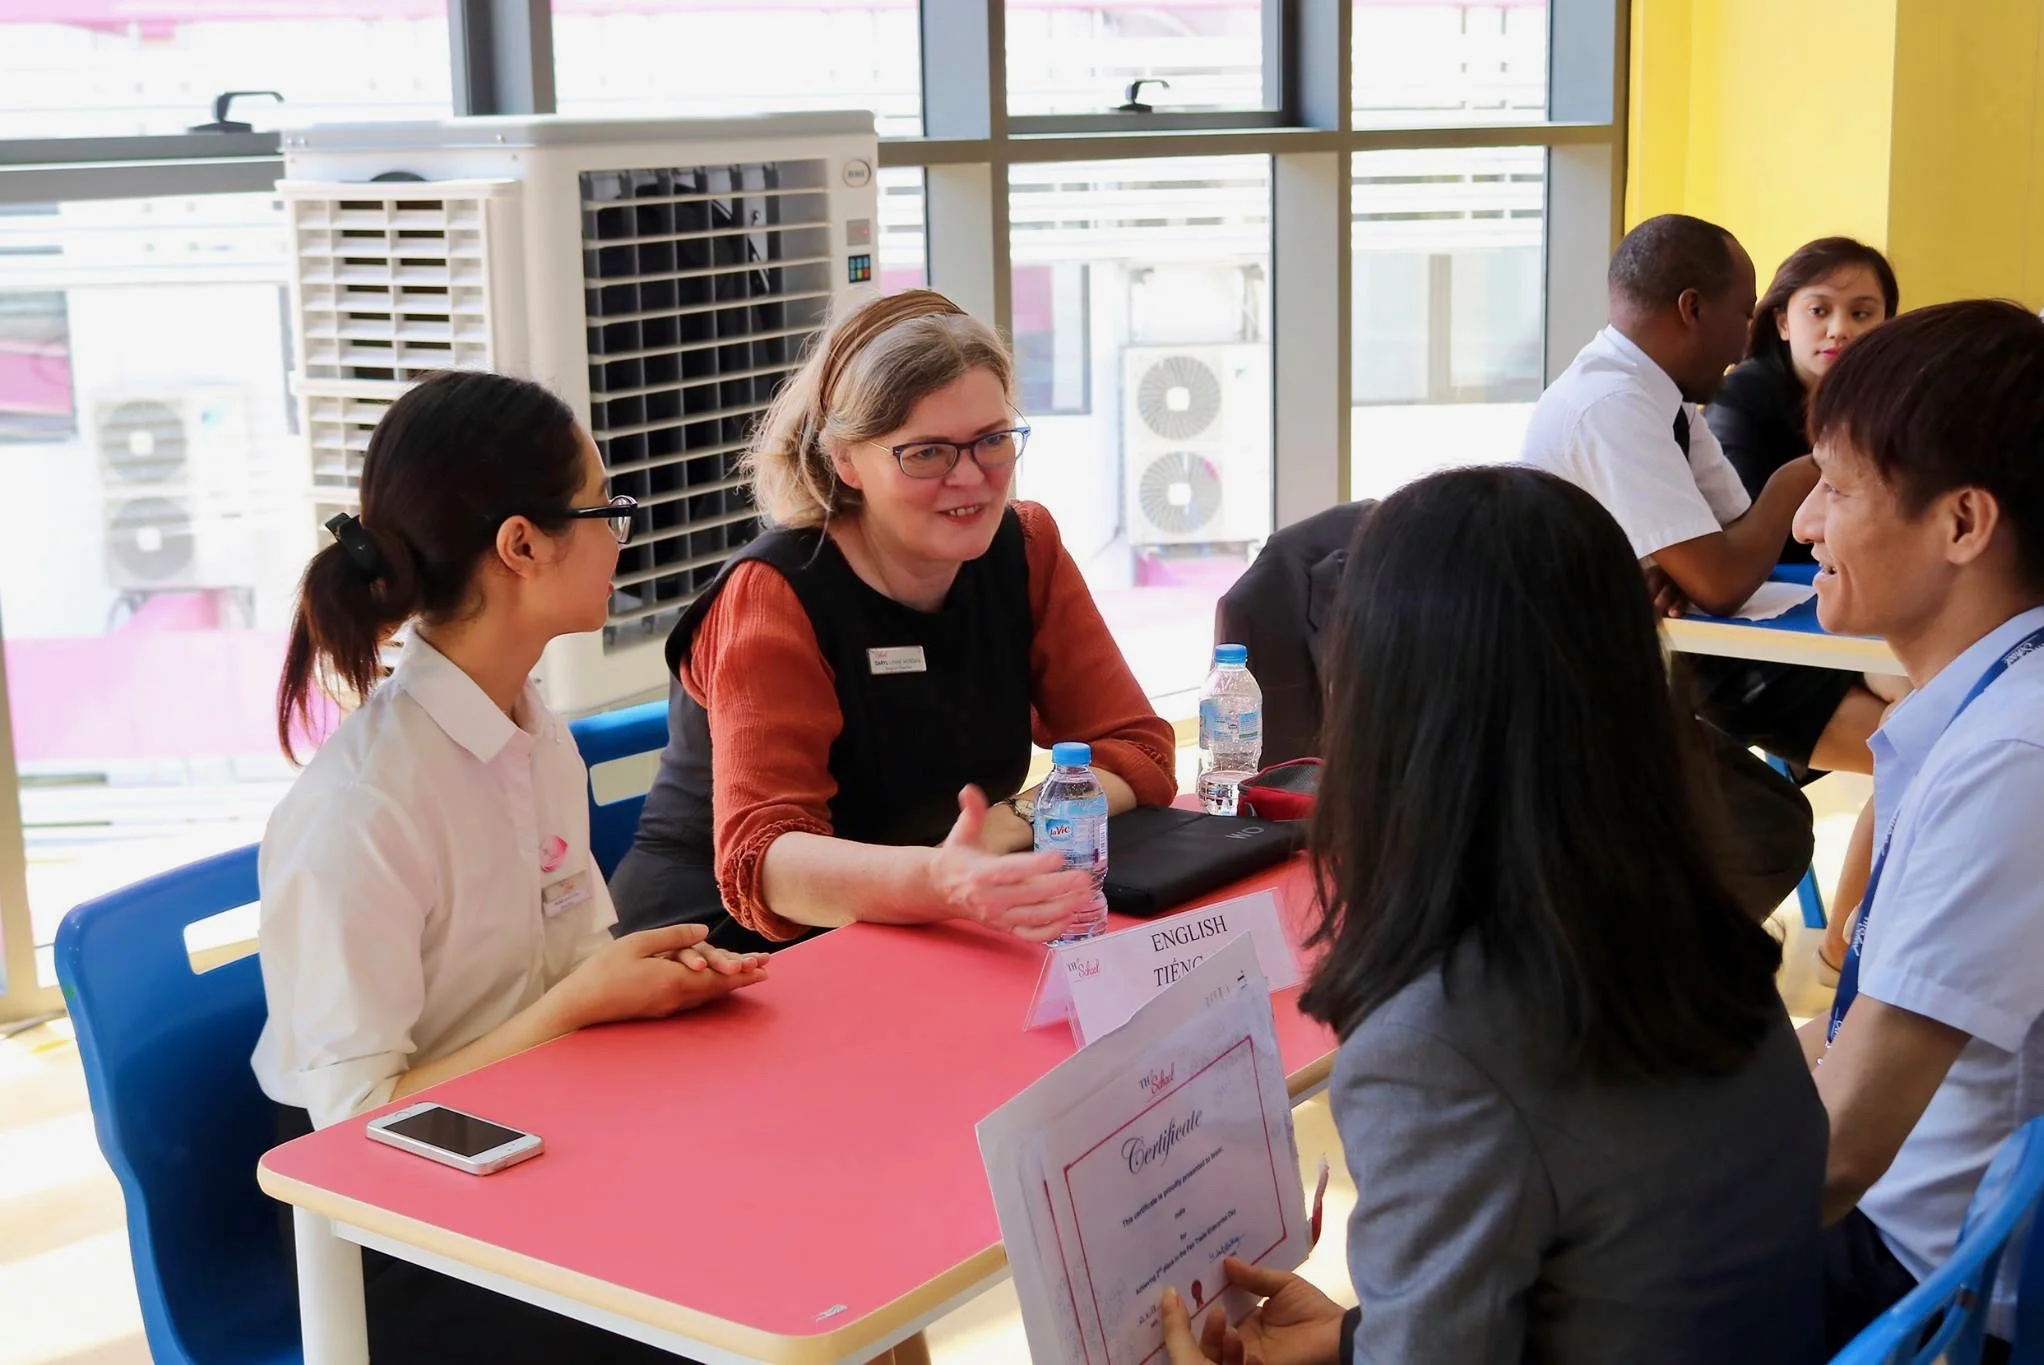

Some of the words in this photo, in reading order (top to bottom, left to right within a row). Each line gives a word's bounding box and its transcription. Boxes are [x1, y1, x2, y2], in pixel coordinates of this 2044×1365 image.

[1151, 915, 1228, 952] ENGLISH
[1121, 1110, 1203, 1174] Certificate
[1122, 1217, 1134, 1228] This
[1133, 1198, 1158, 1220] certificate
[1163, 1179, 1182, 1198] proudly
[1182, 1160, 1206, 1183] presented
